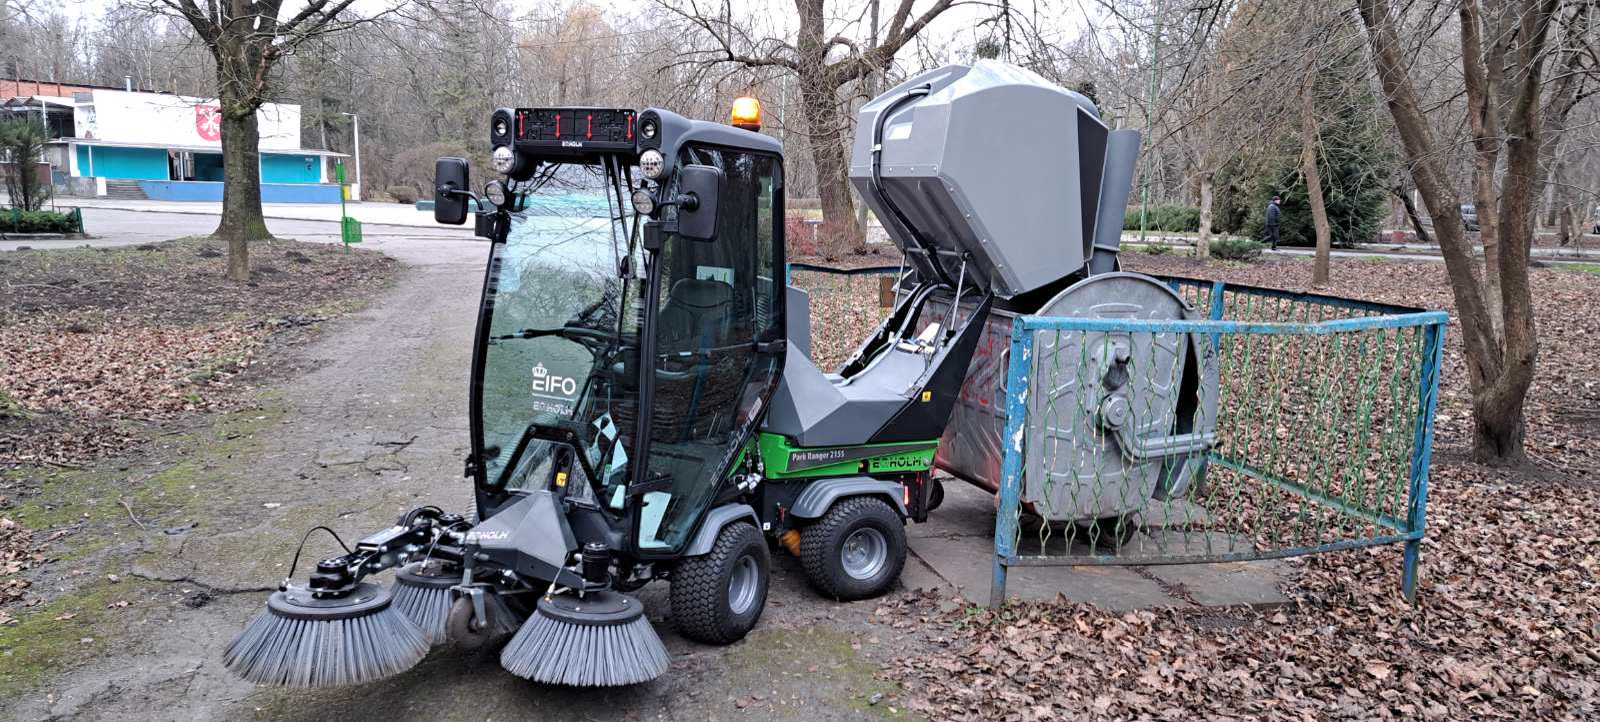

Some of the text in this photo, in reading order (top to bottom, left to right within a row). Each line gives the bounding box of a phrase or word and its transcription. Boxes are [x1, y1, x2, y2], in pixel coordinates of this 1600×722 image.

[532, 375, 576, 395] EIFO
[792, 450, 845, 462] Park Ranger 2155
